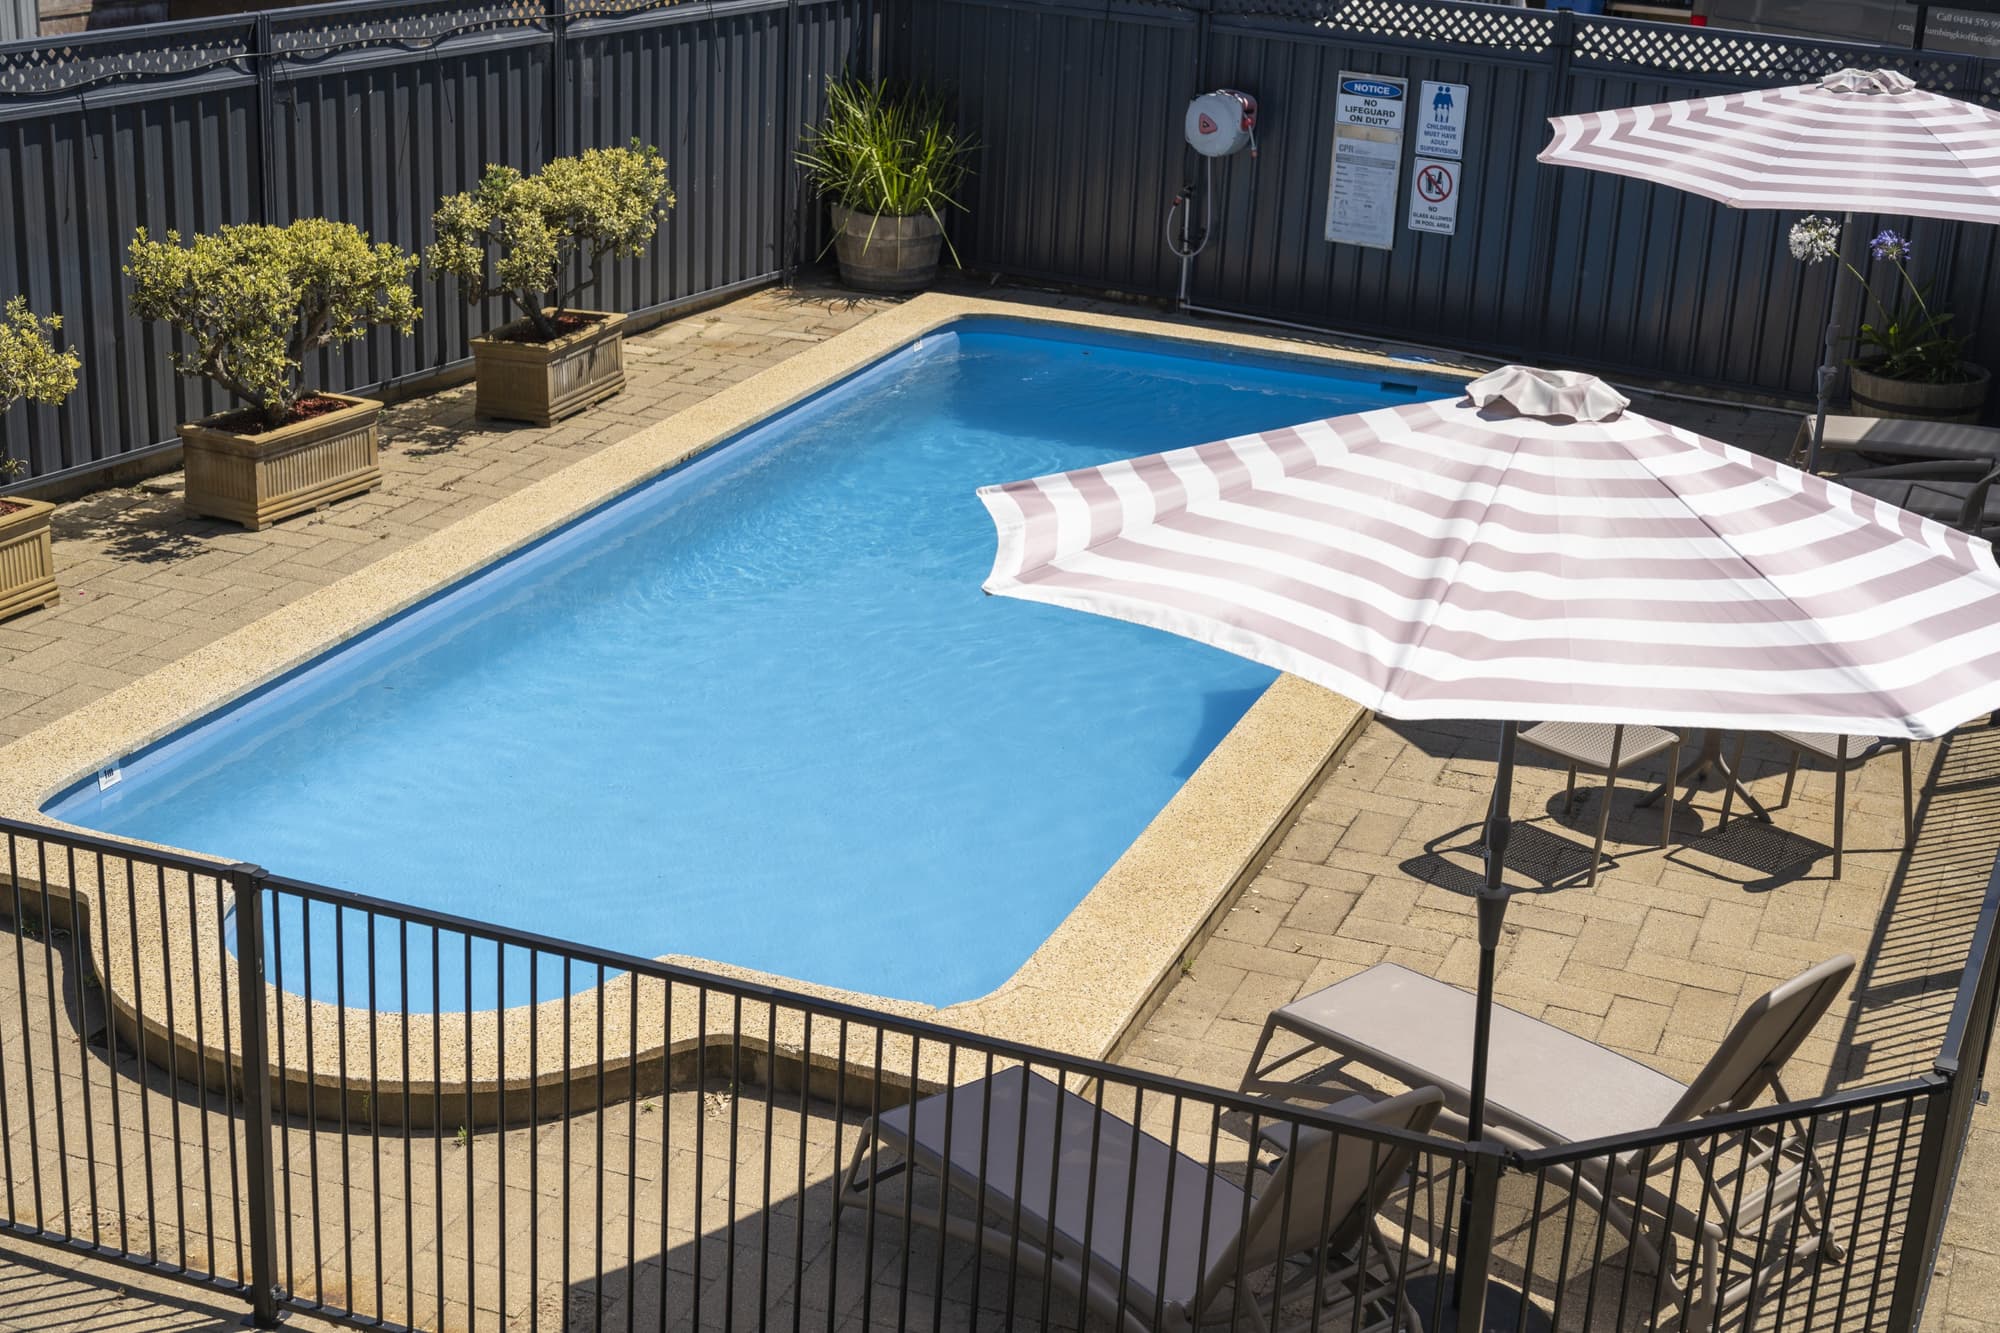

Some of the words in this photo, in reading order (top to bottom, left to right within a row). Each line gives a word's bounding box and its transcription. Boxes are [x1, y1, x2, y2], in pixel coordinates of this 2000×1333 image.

[1936, 12, 1953, 22] Call
[1353, 83, 1390, 95] NOTICE
[1364, 99, 1378, 107] NO
[1345, 105, 1396, 118] LIFEGUARD
[1349, 114, 1363, 122] ON
[1365, 116, 1390, 126] DUTY
[1426, 122, 1456, 132] CHILDREN
[1338, 143, 1354, 153] CPR
[1420, 144, 1458, 155] SUPERVISION
[1429, 214, 1452, 222] ALLOWED
